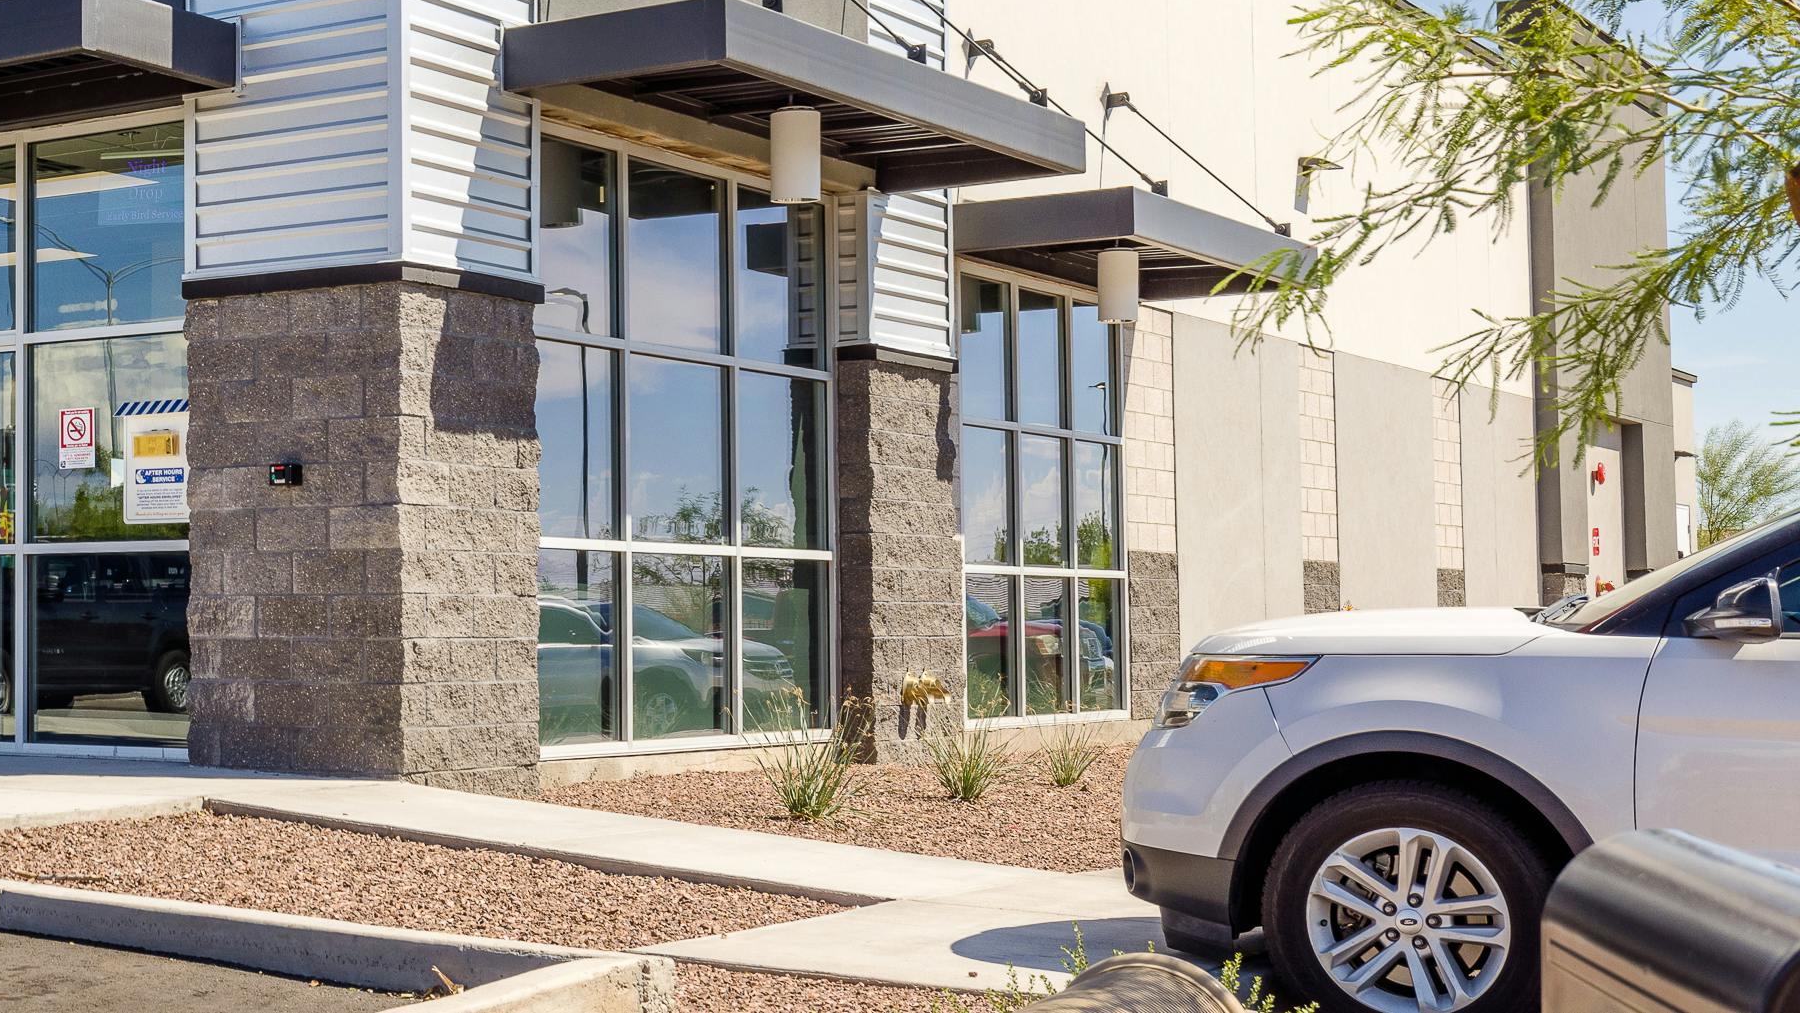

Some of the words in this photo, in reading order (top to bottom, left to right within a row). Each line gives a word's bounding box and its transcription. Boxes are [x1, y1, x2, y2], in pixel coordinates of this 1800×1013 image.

[127, 158, 167, 177] Night
[129, 188, 163, 203] Drop
[151, 209, 184, 220] Service
